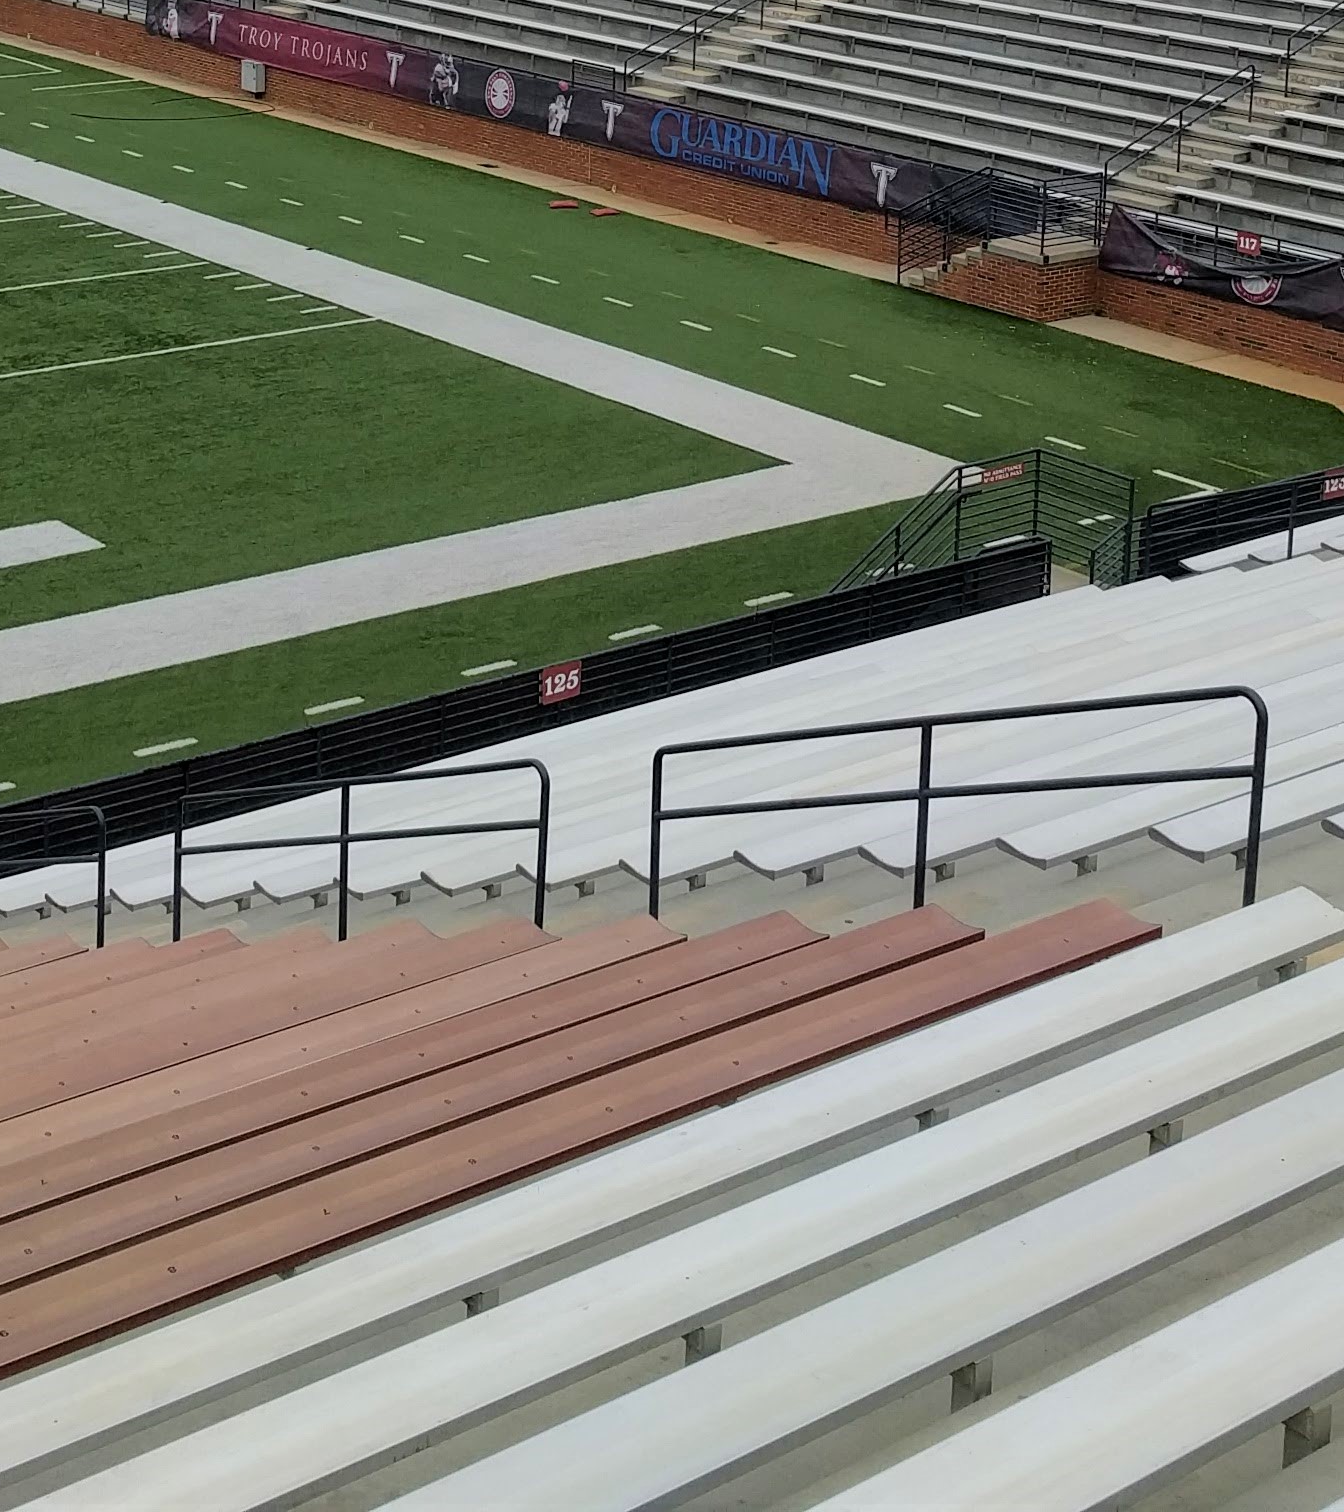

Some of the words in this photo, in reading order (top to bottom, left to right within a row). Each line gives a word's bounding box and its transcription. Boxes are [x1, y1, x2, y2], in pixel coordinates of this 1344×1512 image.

[238, 23, 283, 50] TROY
[290, 35, 369, 72] TROJANS
[649, 107, 837, 197] GUARDIAN
[681, 150, 735, 172] CREDIT
[740, 163, 790, 186] UNION
[1239, 236, 1258, 251] 117
[544, 668, 580, 697] 125
